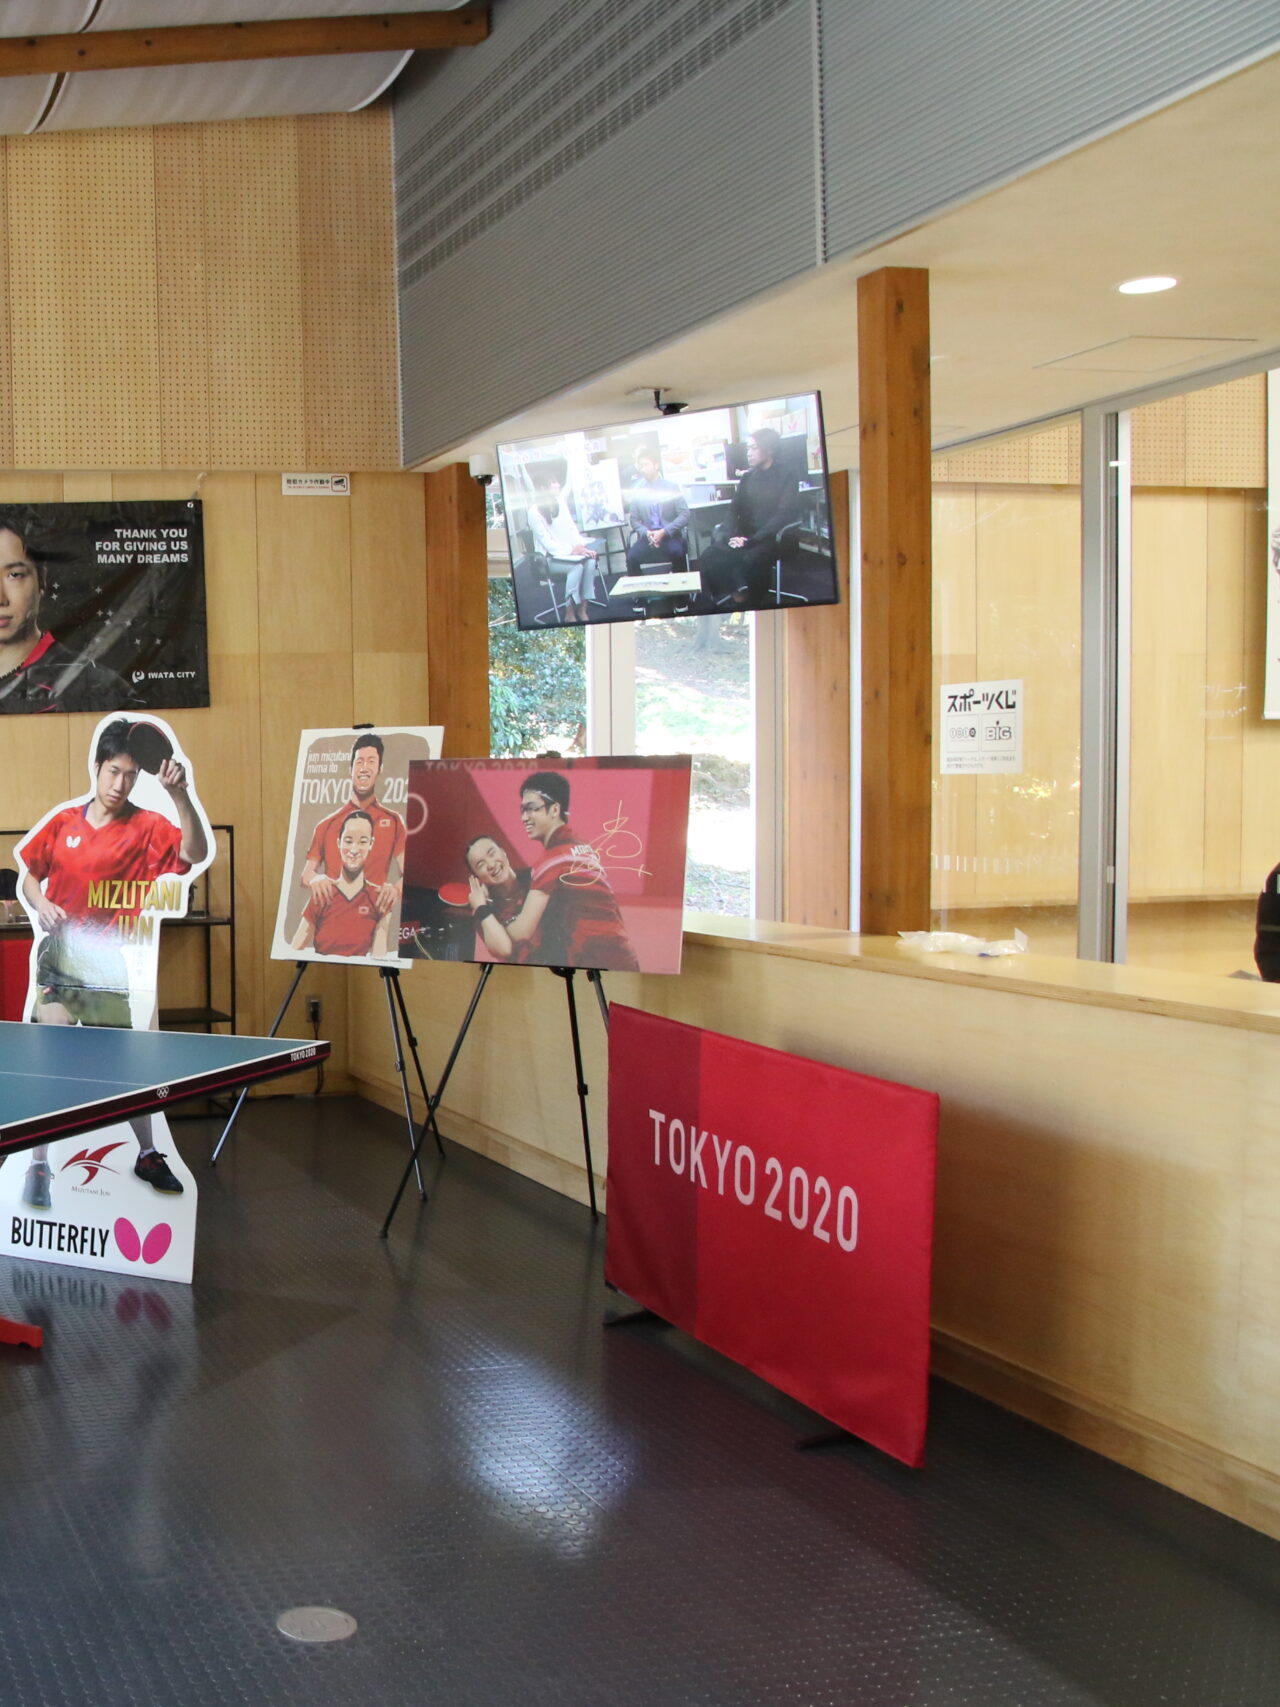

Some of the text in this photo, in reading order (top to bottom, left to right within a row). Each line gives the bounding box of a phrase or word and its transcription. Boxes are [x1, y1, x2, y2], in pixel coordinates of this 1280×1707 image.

[95, 540, 189, 551] FOR GIVING US
[114, 528, 188, 539] THANK YOU
[97, 553, 189, 564] MANY DREAMS
[148, 671, 196, 679] IWATA CITY
[947, 688, 1017, 713] スポーツくじ
[302, 777, 409, 804] TOKYO 20
[87, 879, 182, 912] MIZUTANI
[648, 1108, 859, 1253] TOKYO 2020
[11, 1216, 110, 1258] BUTTERFLY
